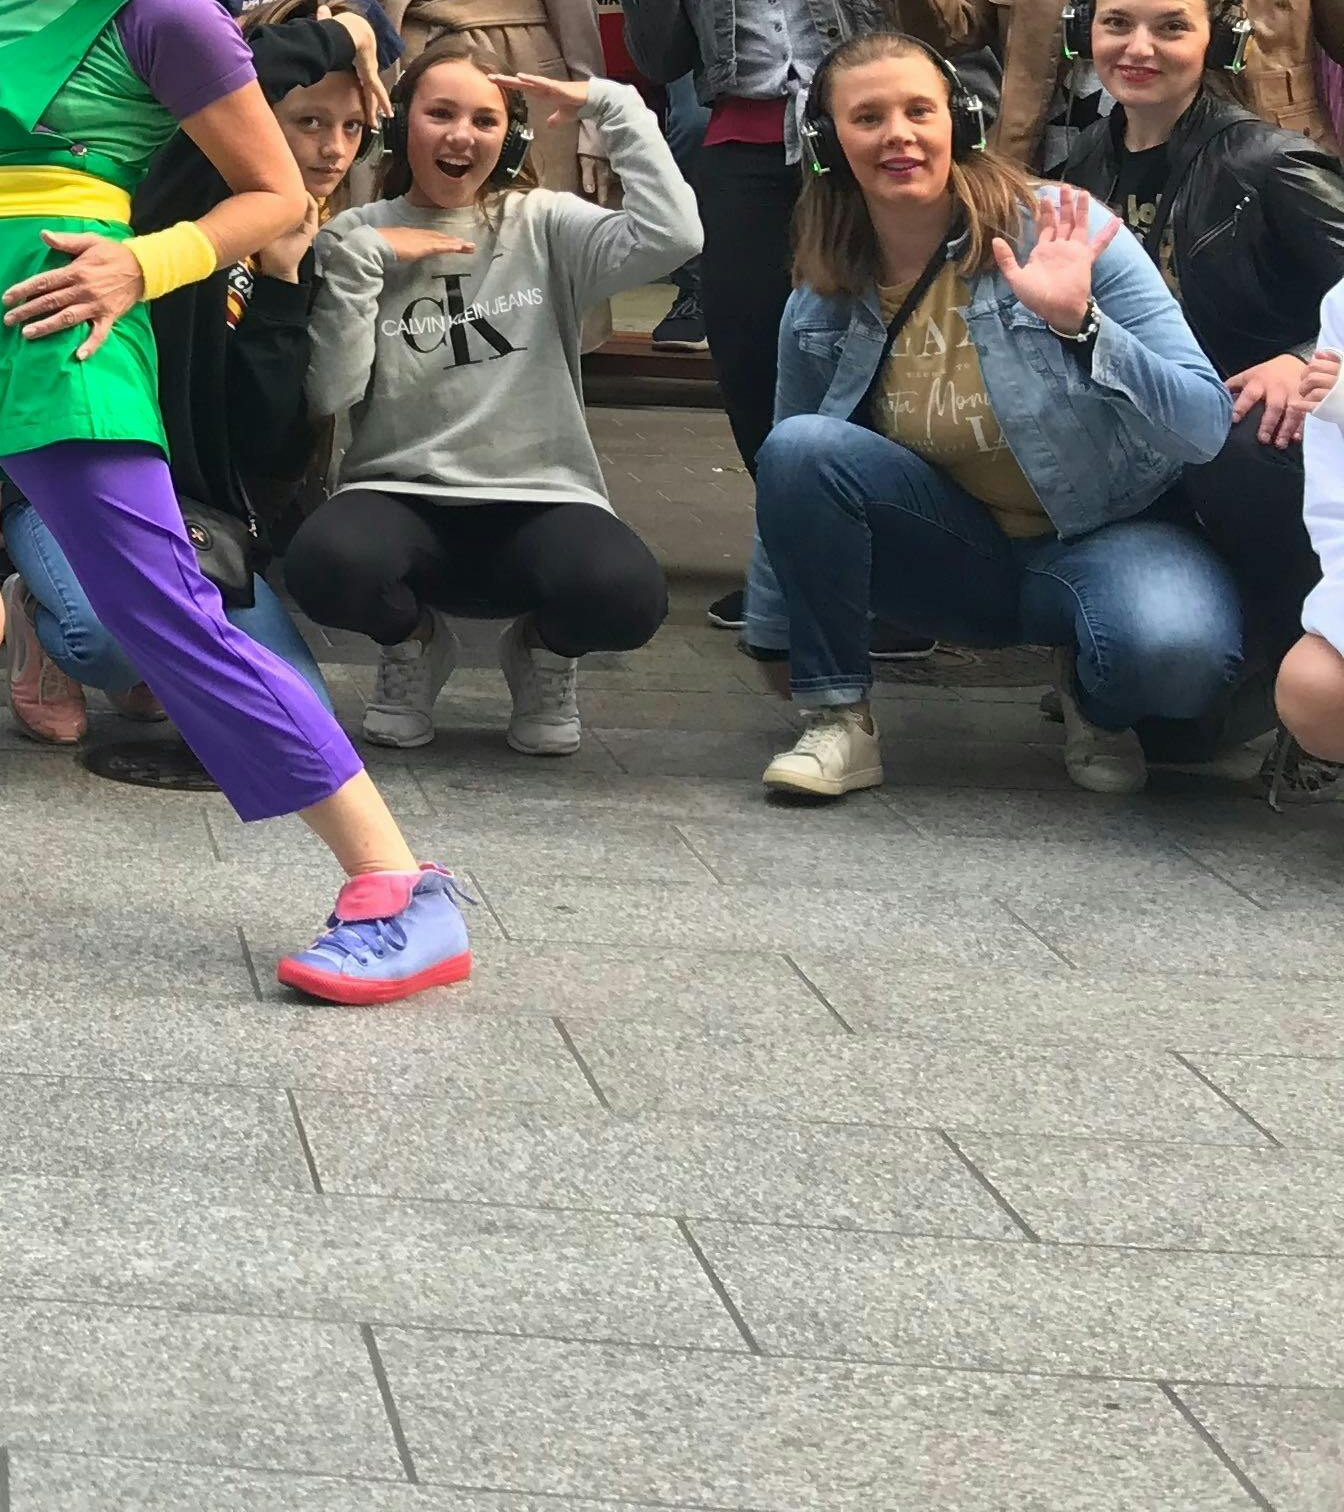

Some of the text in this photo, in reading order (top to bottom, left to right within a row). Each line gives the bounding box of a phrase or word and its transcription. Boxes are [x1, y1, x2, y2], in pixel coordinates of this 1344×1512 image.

[381, 287, 544, 337] CALVIN KLEIN JEANS
